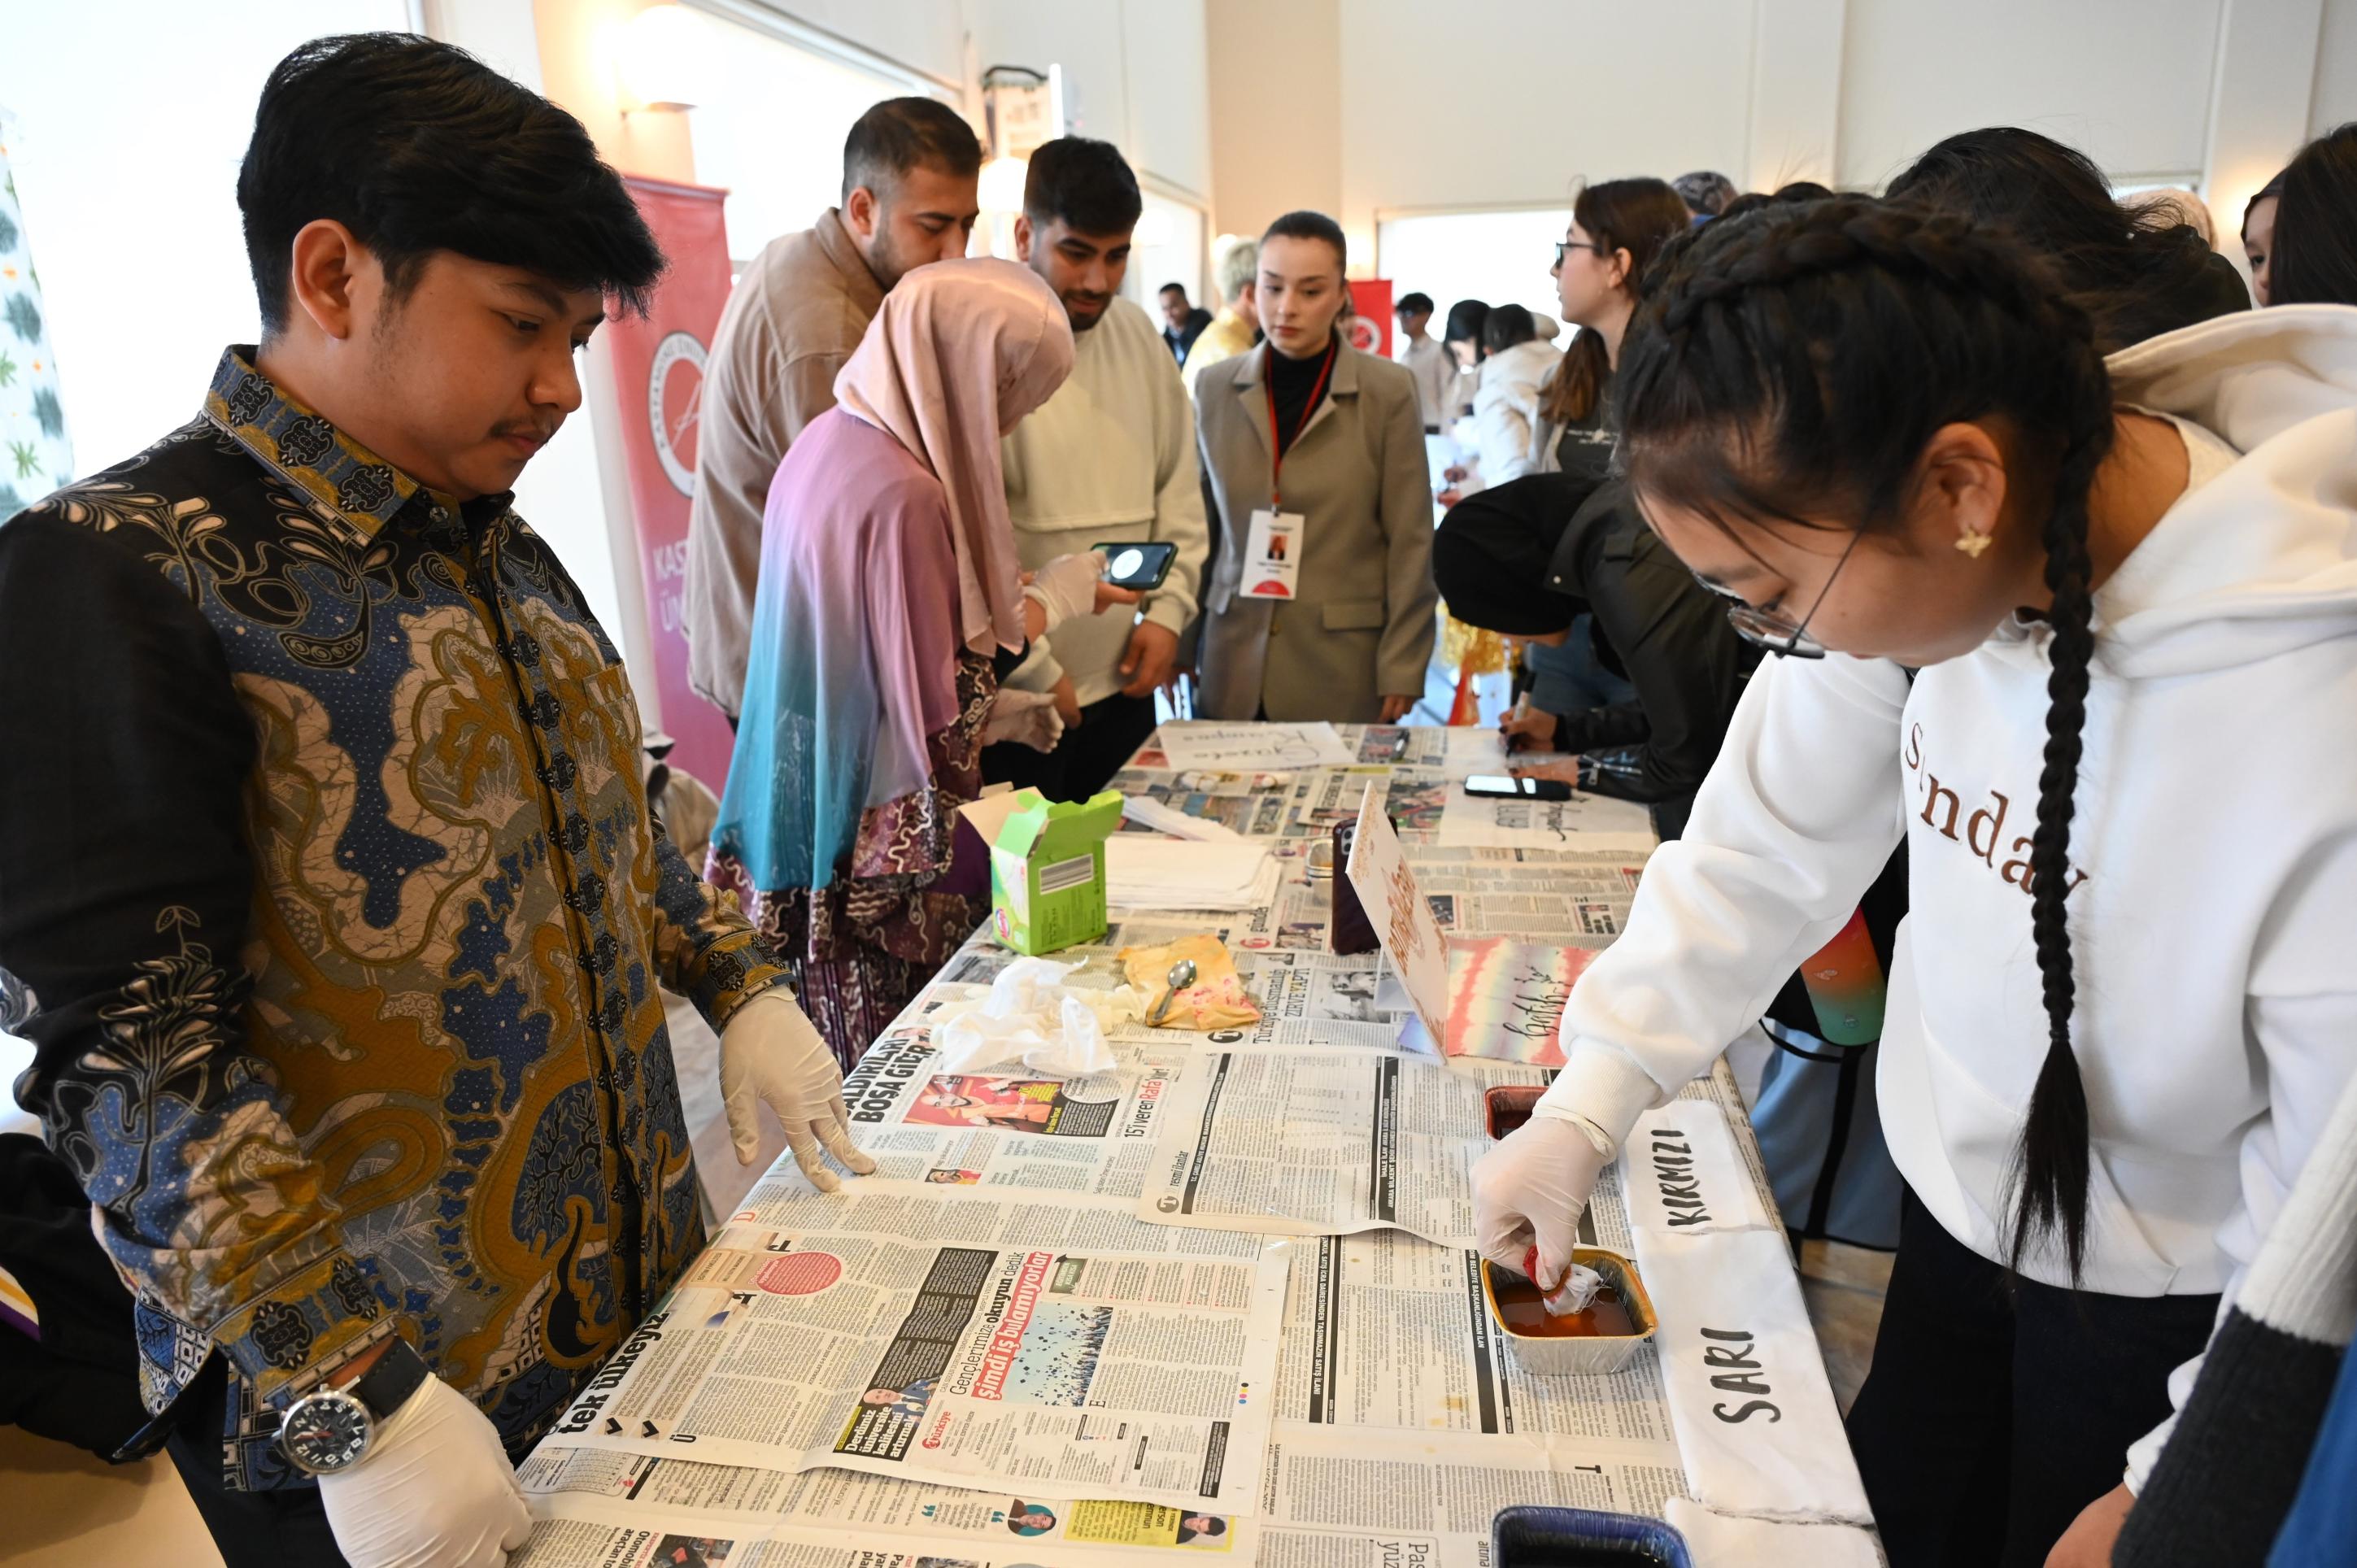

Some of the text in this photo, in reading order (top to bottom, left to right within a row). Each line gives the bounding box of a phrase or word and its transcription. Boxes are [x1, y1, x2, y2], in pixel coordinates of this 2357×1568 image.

[1253, 969, 1292, 1043] Türkiye düşmanlığı
[1281, 968, 1310, 1017] ZİRVE YAPTI
[852, 1082, 906, 1122] BOŞA
[1139, 1079, 1161, 1101] Rafa
[1135, 1100, 1155, 1124] veren
[1170, 1151, 1189, 1187] resmi ilanlar
[1651, 1129, 1712, 1226] KIRMIZI
[1469, 1260, 1478, 1283] BELEDİYE
[948, 1250, 1026, 1395] Gençlerimize okuyun dedik
[1317, 1283, 1327, 1320] DAİRESİNDEN
[1470, 1285, 1483, 1334] BAŞKANLIĞINDAN
[976, 1251, 1050, 1400] şimdi iş bulamıyorlar
[1314, 1322, 1323, 1357] TAŞINMAZIN
[559, 1312, 669, 1435] tek ülkeyiz
[1312, 1359, 1322, 1376] SATIŞ
[1313, 1377, 1322, 1394] İLANI
[1700, 1327, 1781, 1423] SARI
[844, 1409, 877, 1451] Derdimiz
[859, 1406, 892, 1453] üniversite
[871, 1411, 905, 1455] kalitesini
[609, 1528, 634, 1557] araçtan
